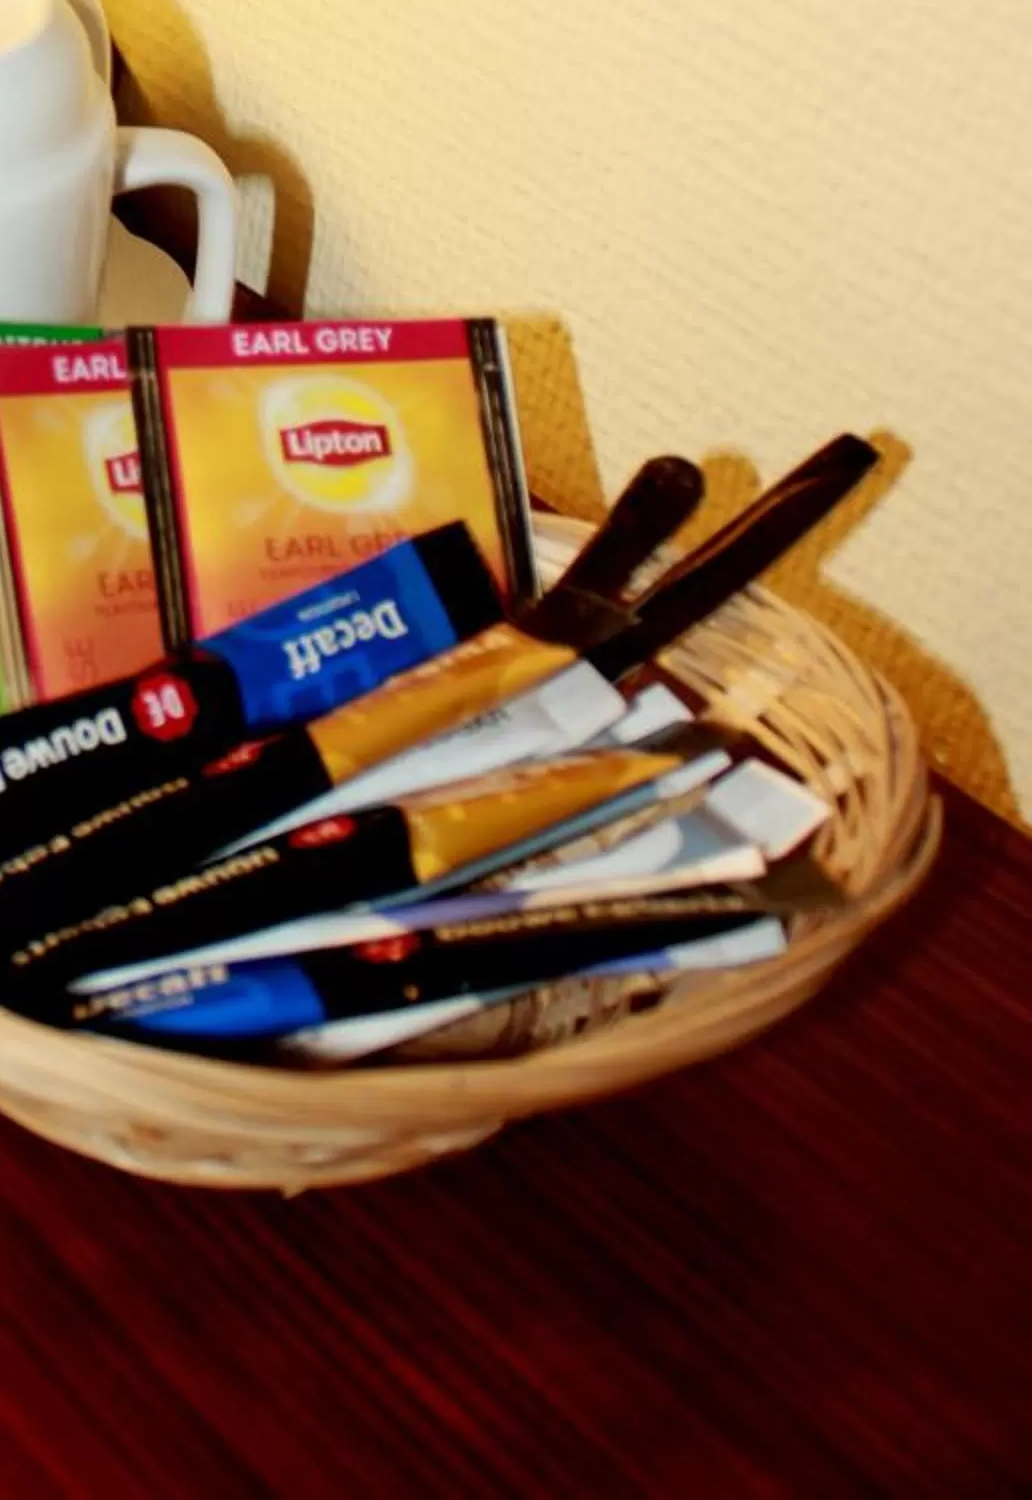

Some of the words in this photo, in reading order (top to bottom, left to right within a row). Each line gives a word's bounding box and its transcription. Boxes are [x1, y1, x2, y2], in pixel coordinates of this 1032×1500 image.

[233, 329, 310, 356] EARL
[314, 327, 392, 353] GREY
[52, 356, 127, 383] EARL
[286, 429, 384, 460] Lipton
[264, 532, 339, 561] EARL
[97, 570, 155, 598] EAR
[282, 598, 409, 681] Decaff
[139, 684, 185, 728] DE
[0, 707, 127, 781] Douwe
